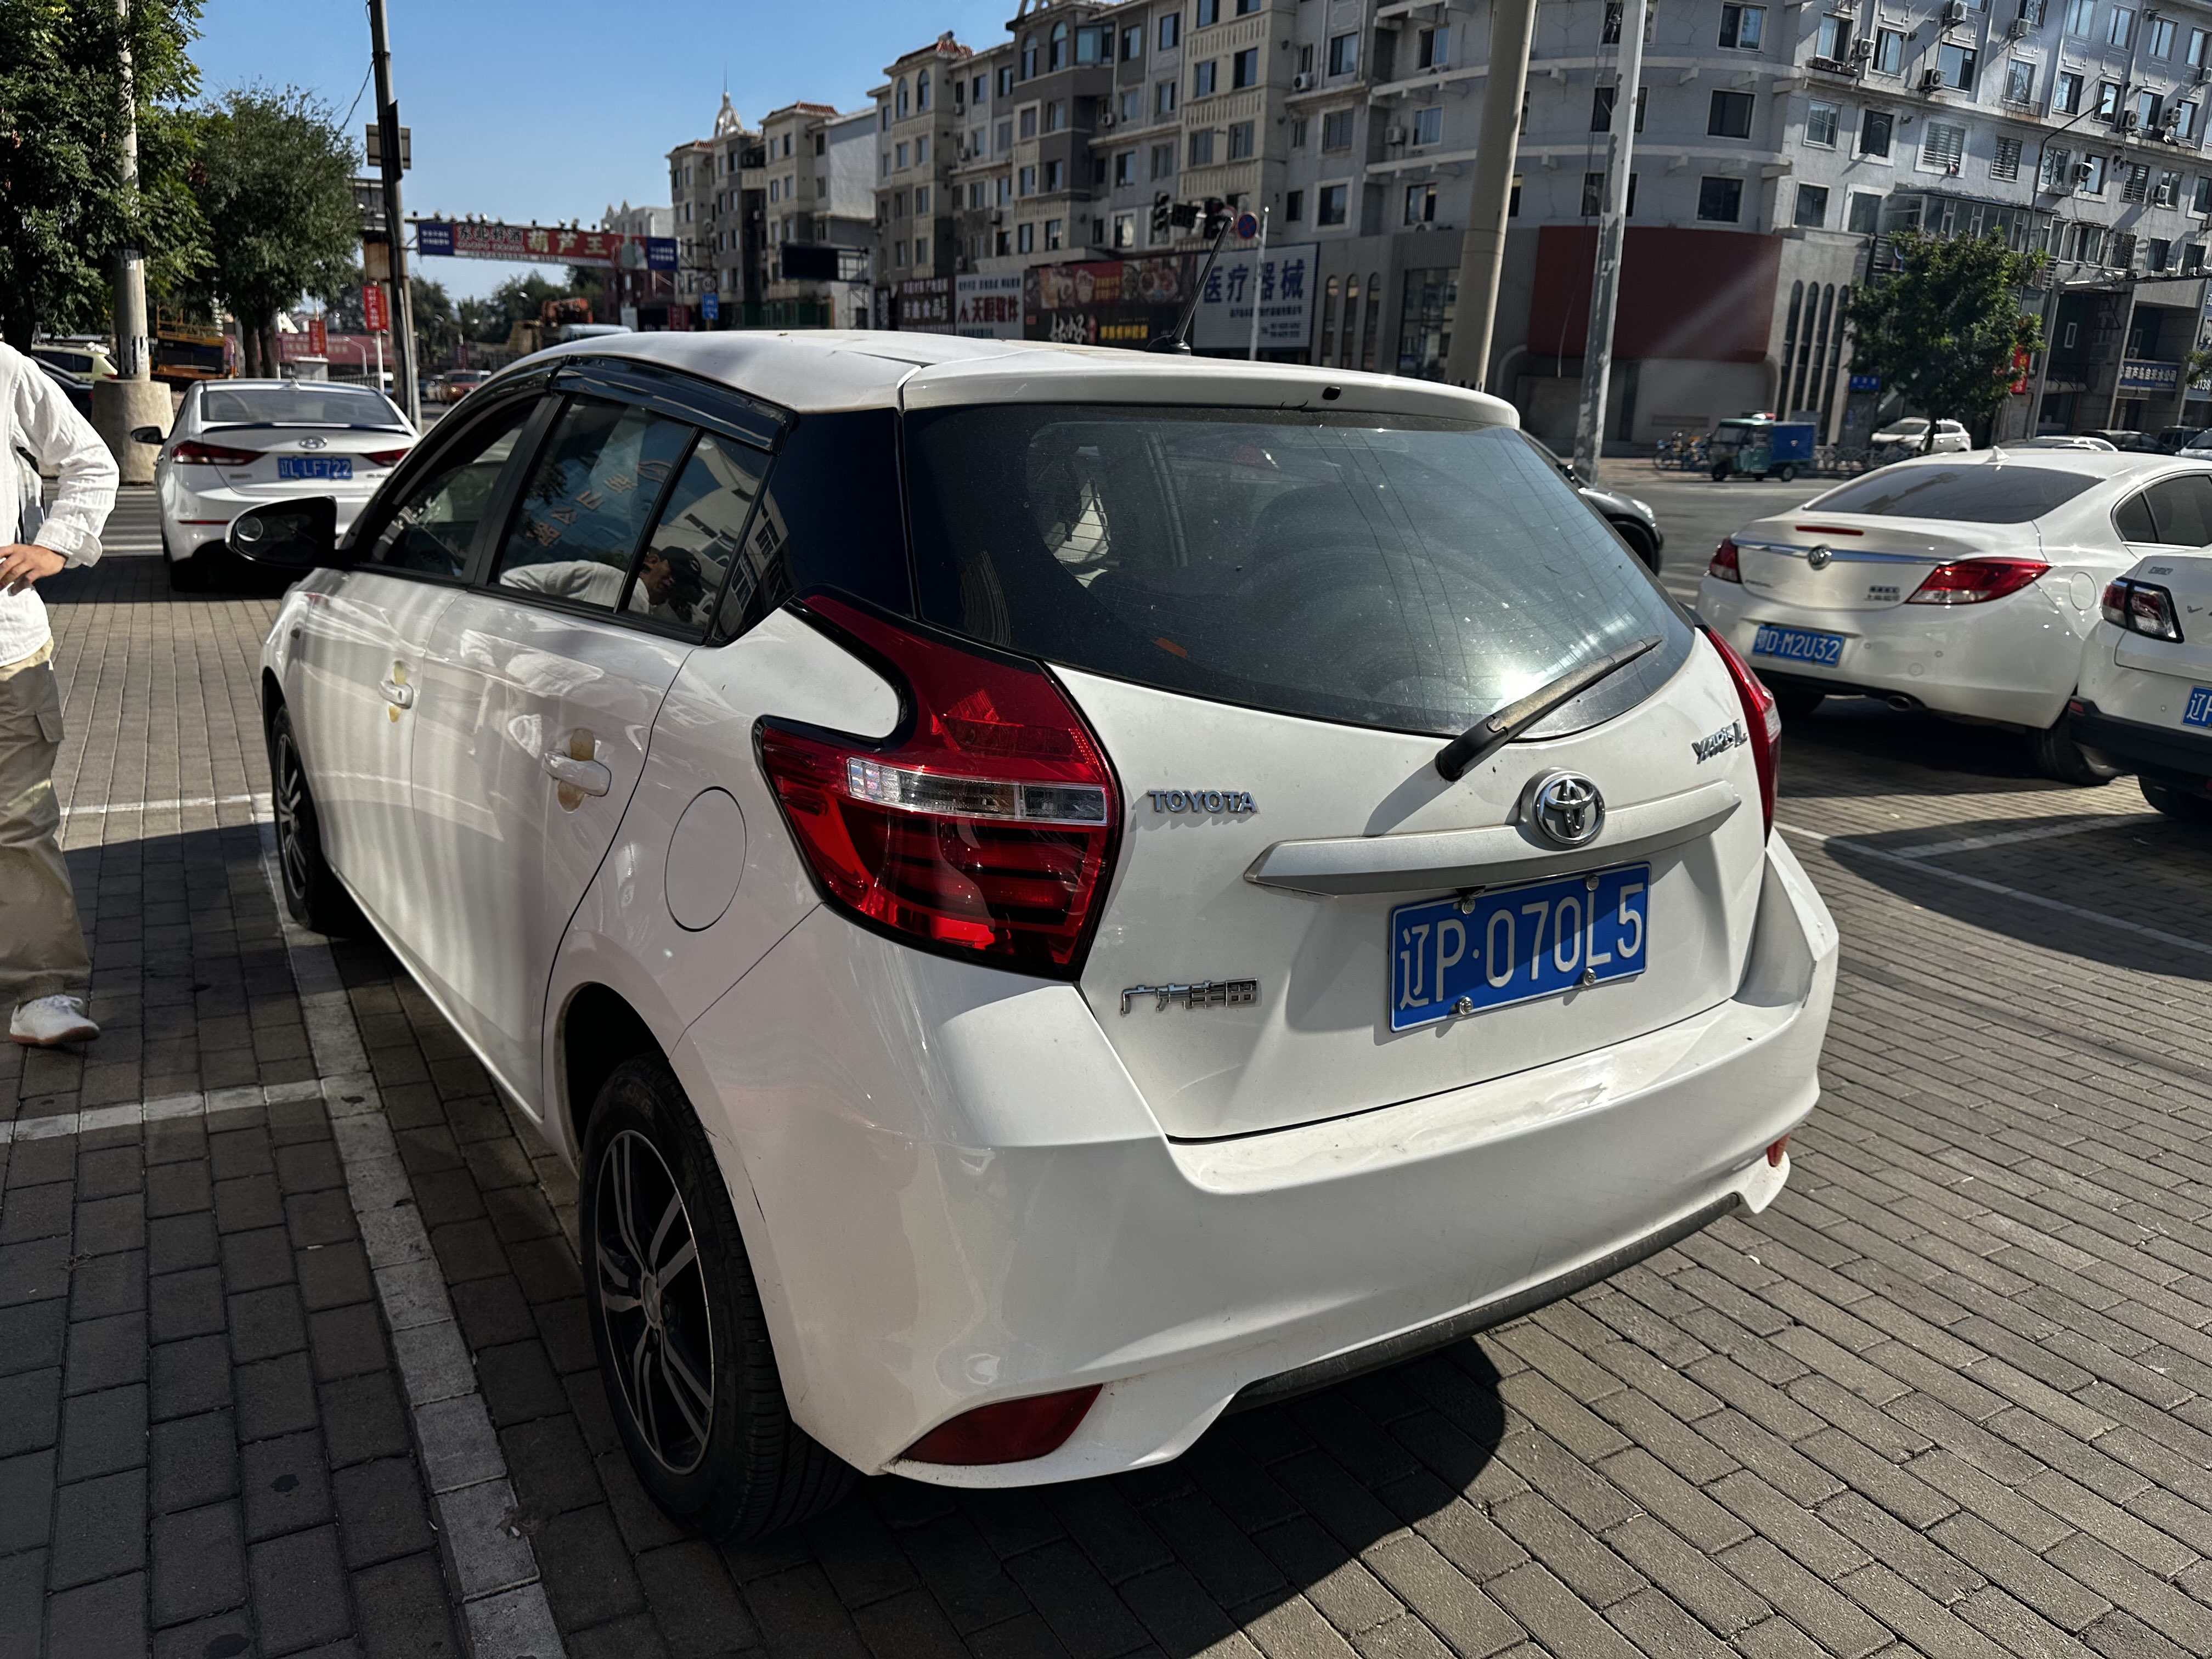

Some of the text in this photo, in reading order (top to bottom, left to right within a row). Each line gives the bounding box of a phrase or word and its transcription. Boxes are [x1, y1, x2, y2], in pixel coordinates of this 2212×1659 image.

[527, 229, 607, 255] 葫芦王
[1203, 259, 1304, 303] 医疗器械
[1148, 790, 1257, 812] TOYOTA
[1120, 978, 1257, 1016] 广汽丰田
